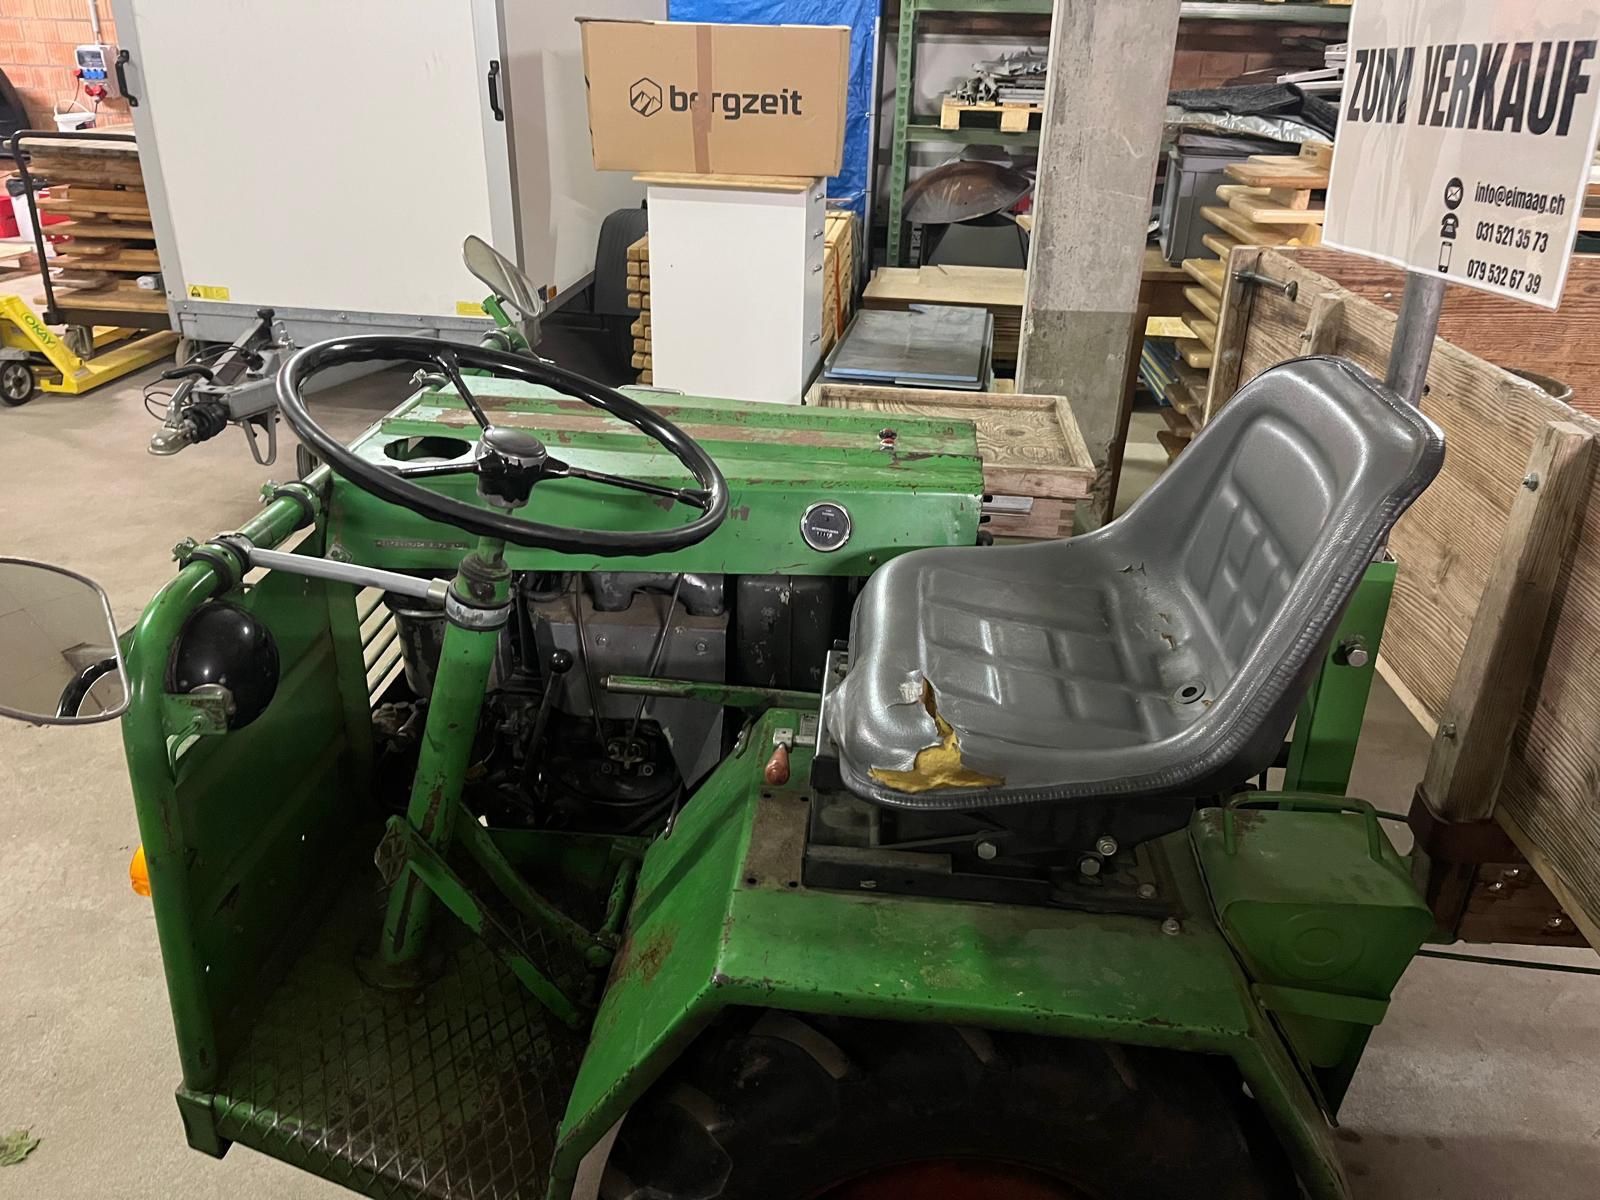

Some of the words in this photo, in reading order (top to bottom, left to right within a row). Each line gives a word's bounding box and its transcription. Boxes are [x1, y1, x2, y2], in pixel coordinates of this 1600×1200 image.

[1346, 47, 1416, 124] ZUM
[1418, 40, 1598, 136] VERKAUF
[1475, 182, 1565, 215] info@eimaag.ch
[1476, 221, 1495, 242] 031
[1495, 225, 1515, 246] 521
[1516, 229, 1531, 249] 35
[1532, 231, 1548, 253] 73
[1467, 259, 1487, 280] 079
[1488, 264, 1509, 286] 532
[1509, 269, 1525, 289] 67
[1525, 273, 1541, 294] 39
[25, 315, 56, 344] OKAY
